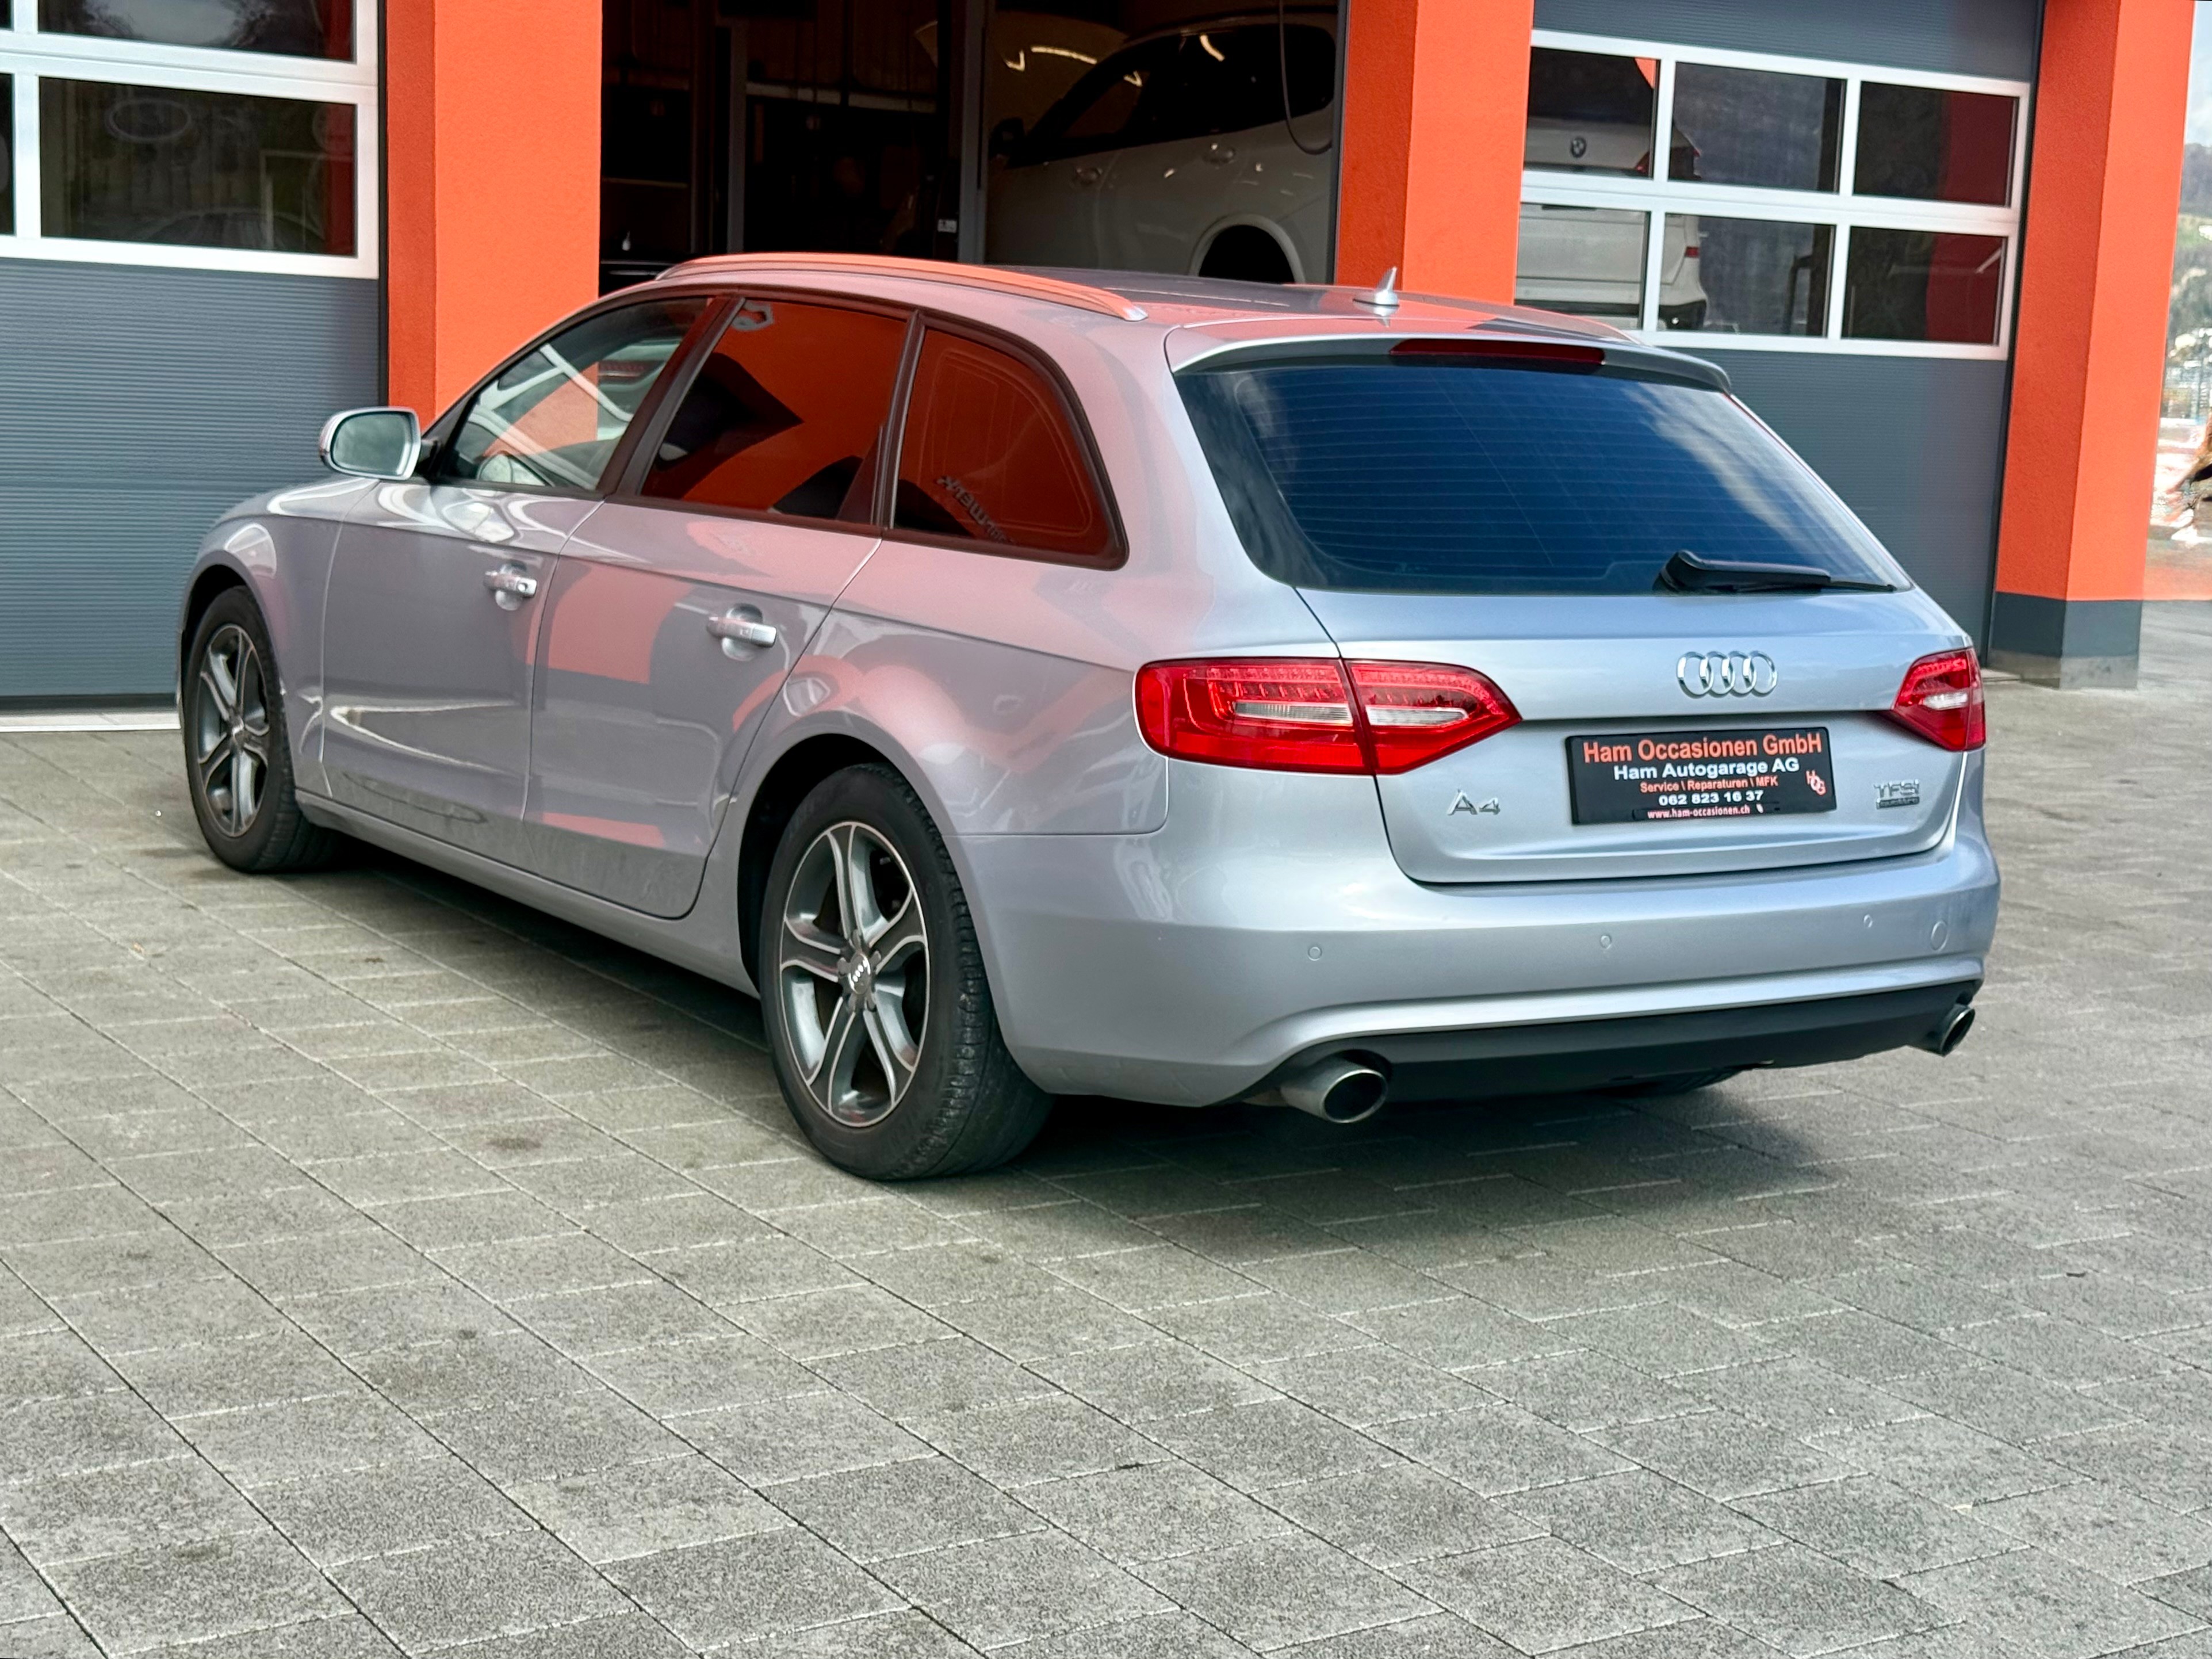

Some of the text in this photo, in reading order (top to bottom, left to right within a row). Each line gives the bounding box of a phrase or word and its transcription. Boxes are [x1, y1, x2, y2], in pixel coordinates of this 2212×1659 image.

[1583, 732, 1822, 763] Ham Occasionen GmbH
[1614, 757, 1800, 780] Ham Autogarage AG
[1640, 781, 1679, 793] Service
[1687, 779, 1748, 792] Reparaturen
[1756, 776, 1778, 787] MFK
[1873, 779, 1919, 798] TFSI
[1447, 789, 1501, 816] A4
[1659, 790, 1765, 806] 062 823 16 37
[1647, 804, 1751, 819] www.ham-occasionen.ch
